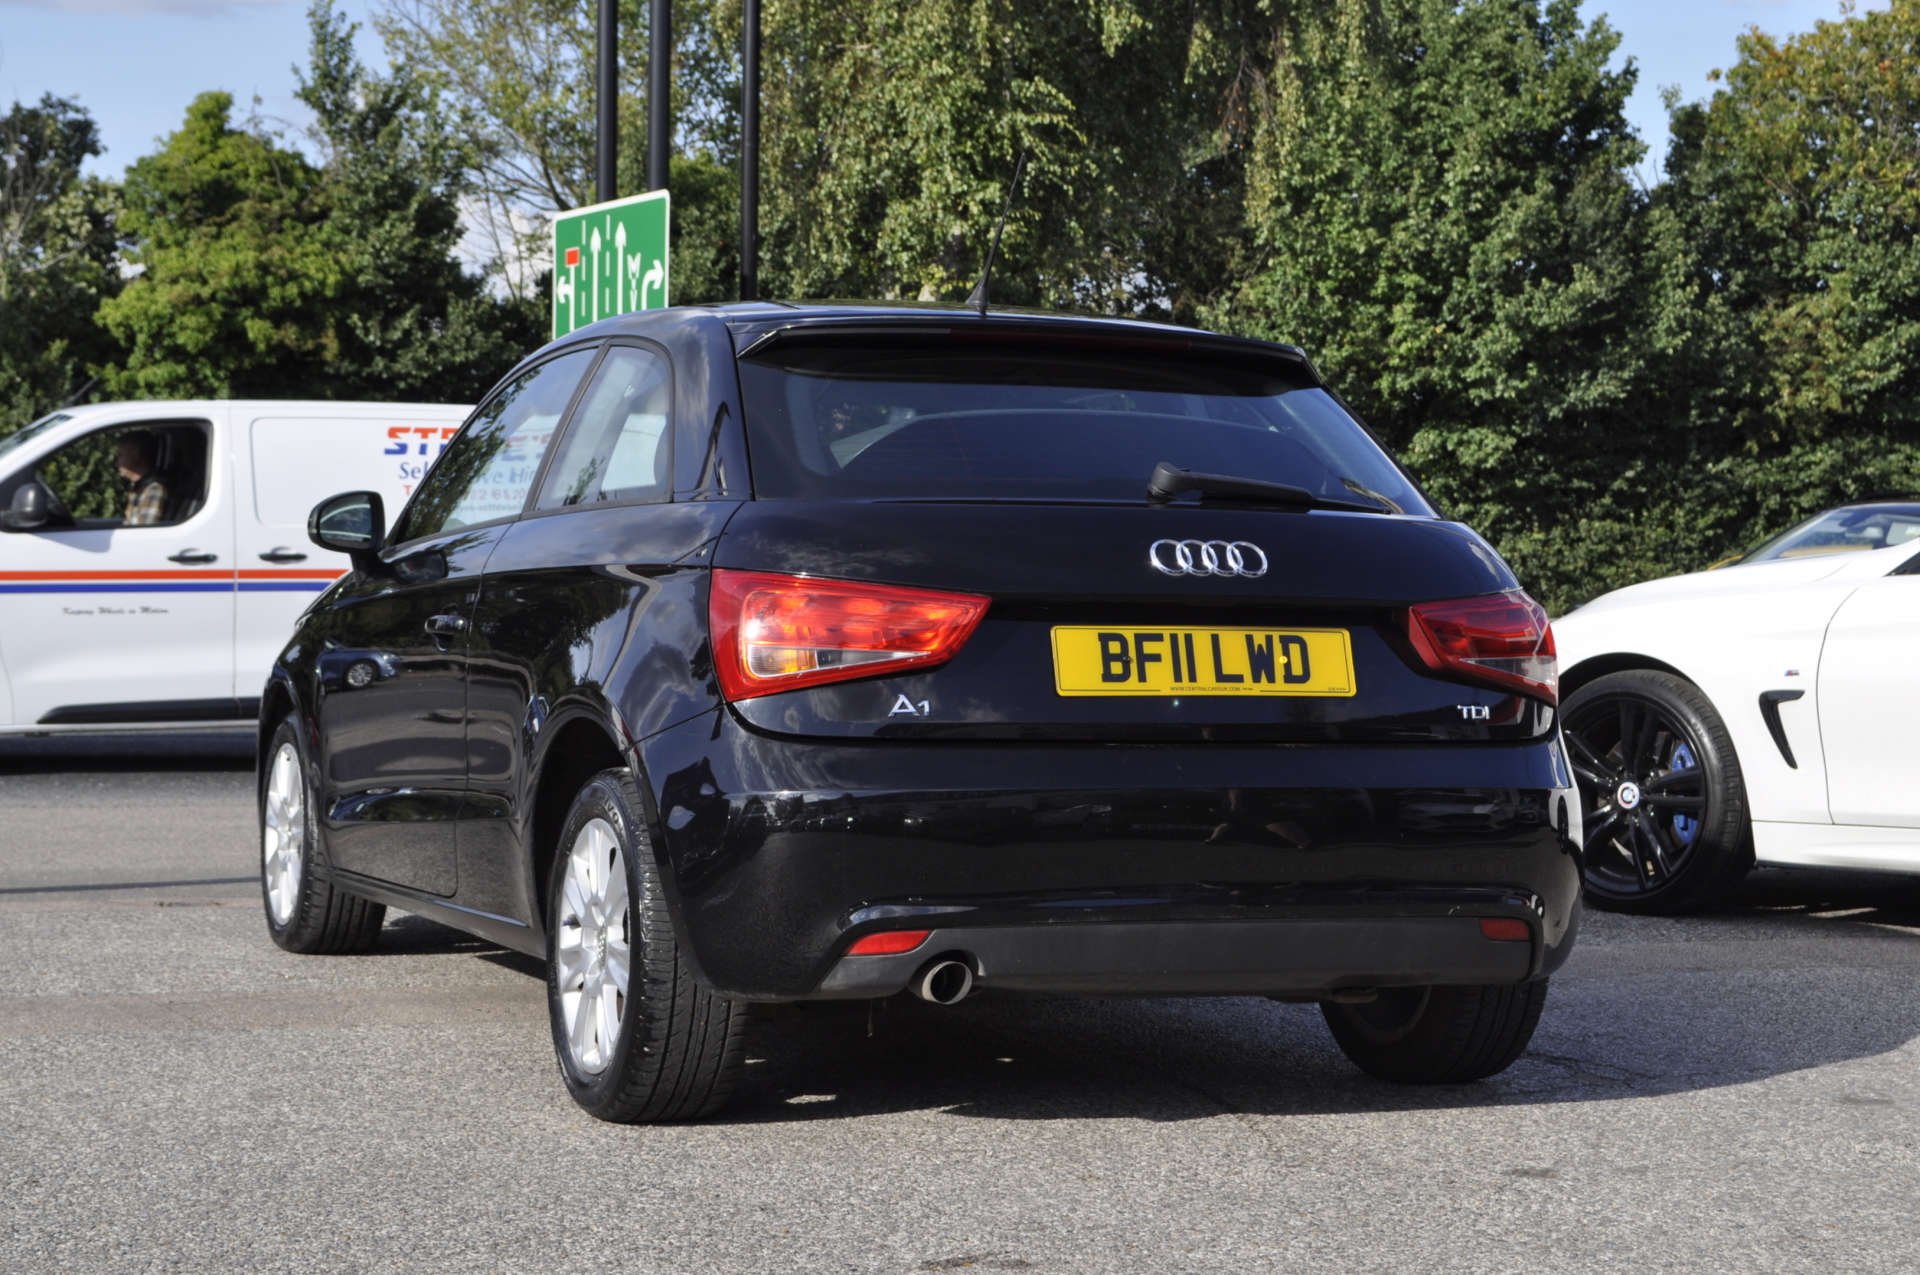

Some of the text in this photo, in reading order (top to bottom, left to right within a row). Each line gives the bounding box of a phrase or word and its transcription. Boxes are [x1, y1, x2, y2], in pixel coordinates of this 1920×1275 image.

[1098, 632, 1311, 684] BF11 LWD
[887, 693, 931, 718] A1
[1457, 704, 1491, 720] TDI
